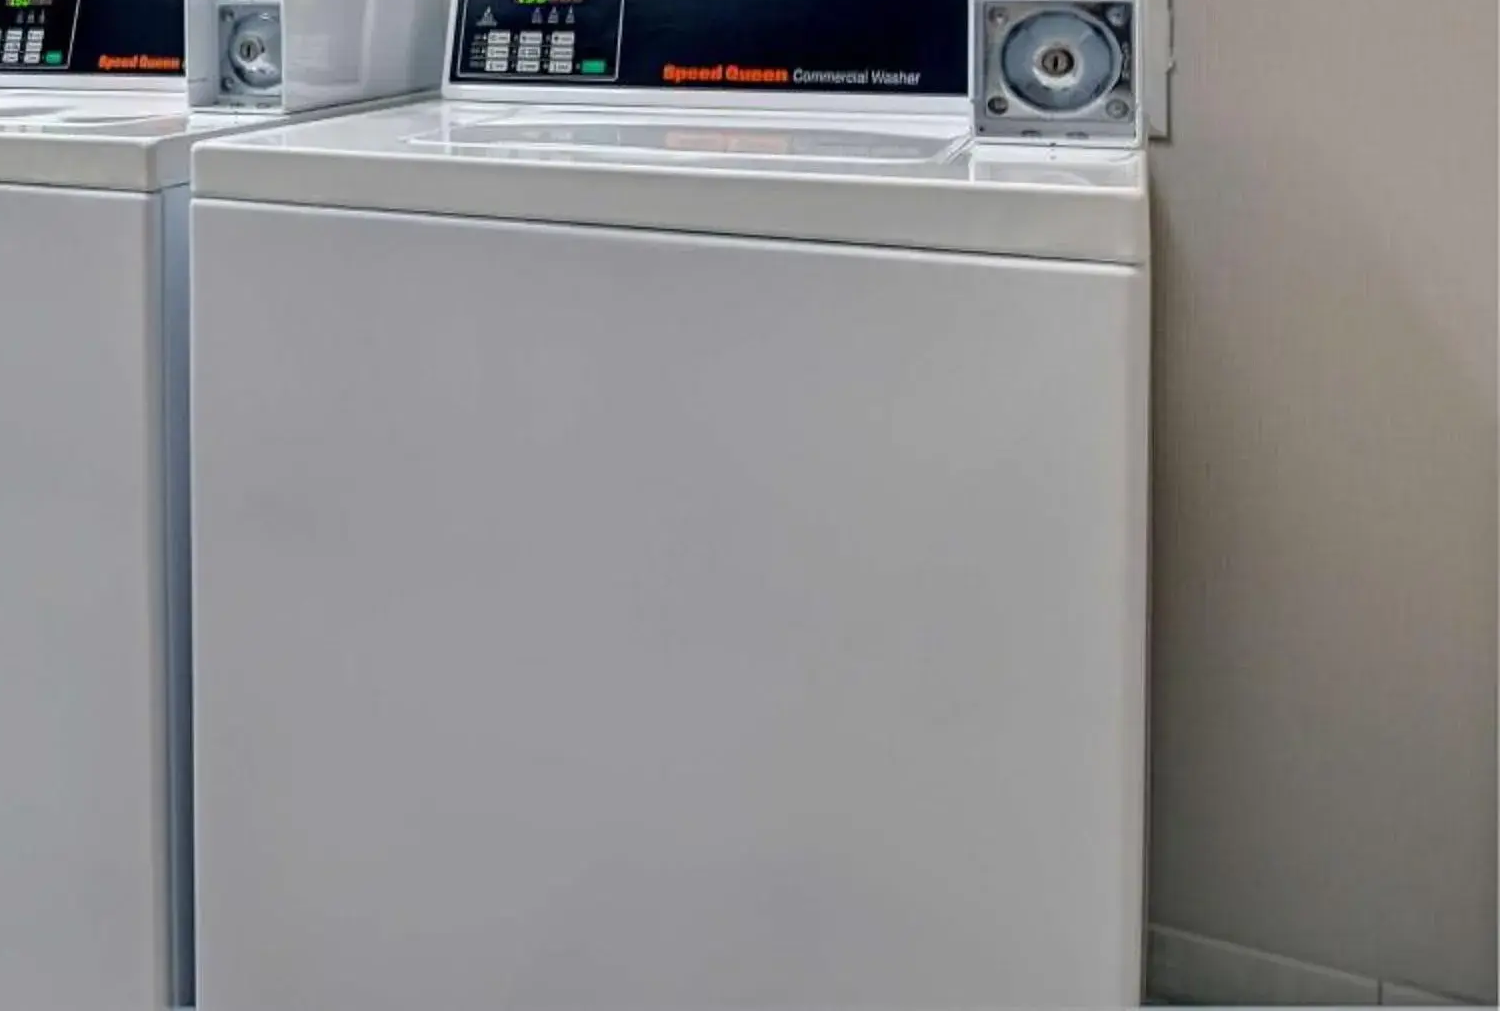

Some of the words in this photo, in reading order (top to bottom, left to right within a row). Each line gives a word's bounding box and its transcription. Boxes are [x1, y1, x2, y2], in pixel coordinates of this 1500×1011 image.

[98, 54, 138, 71] Speed
[139, 54, 180, 70] Queen
[663, 64, 722, 83] Speed
[725, 65, 789, 82] Queen
[793, 68, 868, 85] Commercial
[871, 71, 921, 86] Washer
